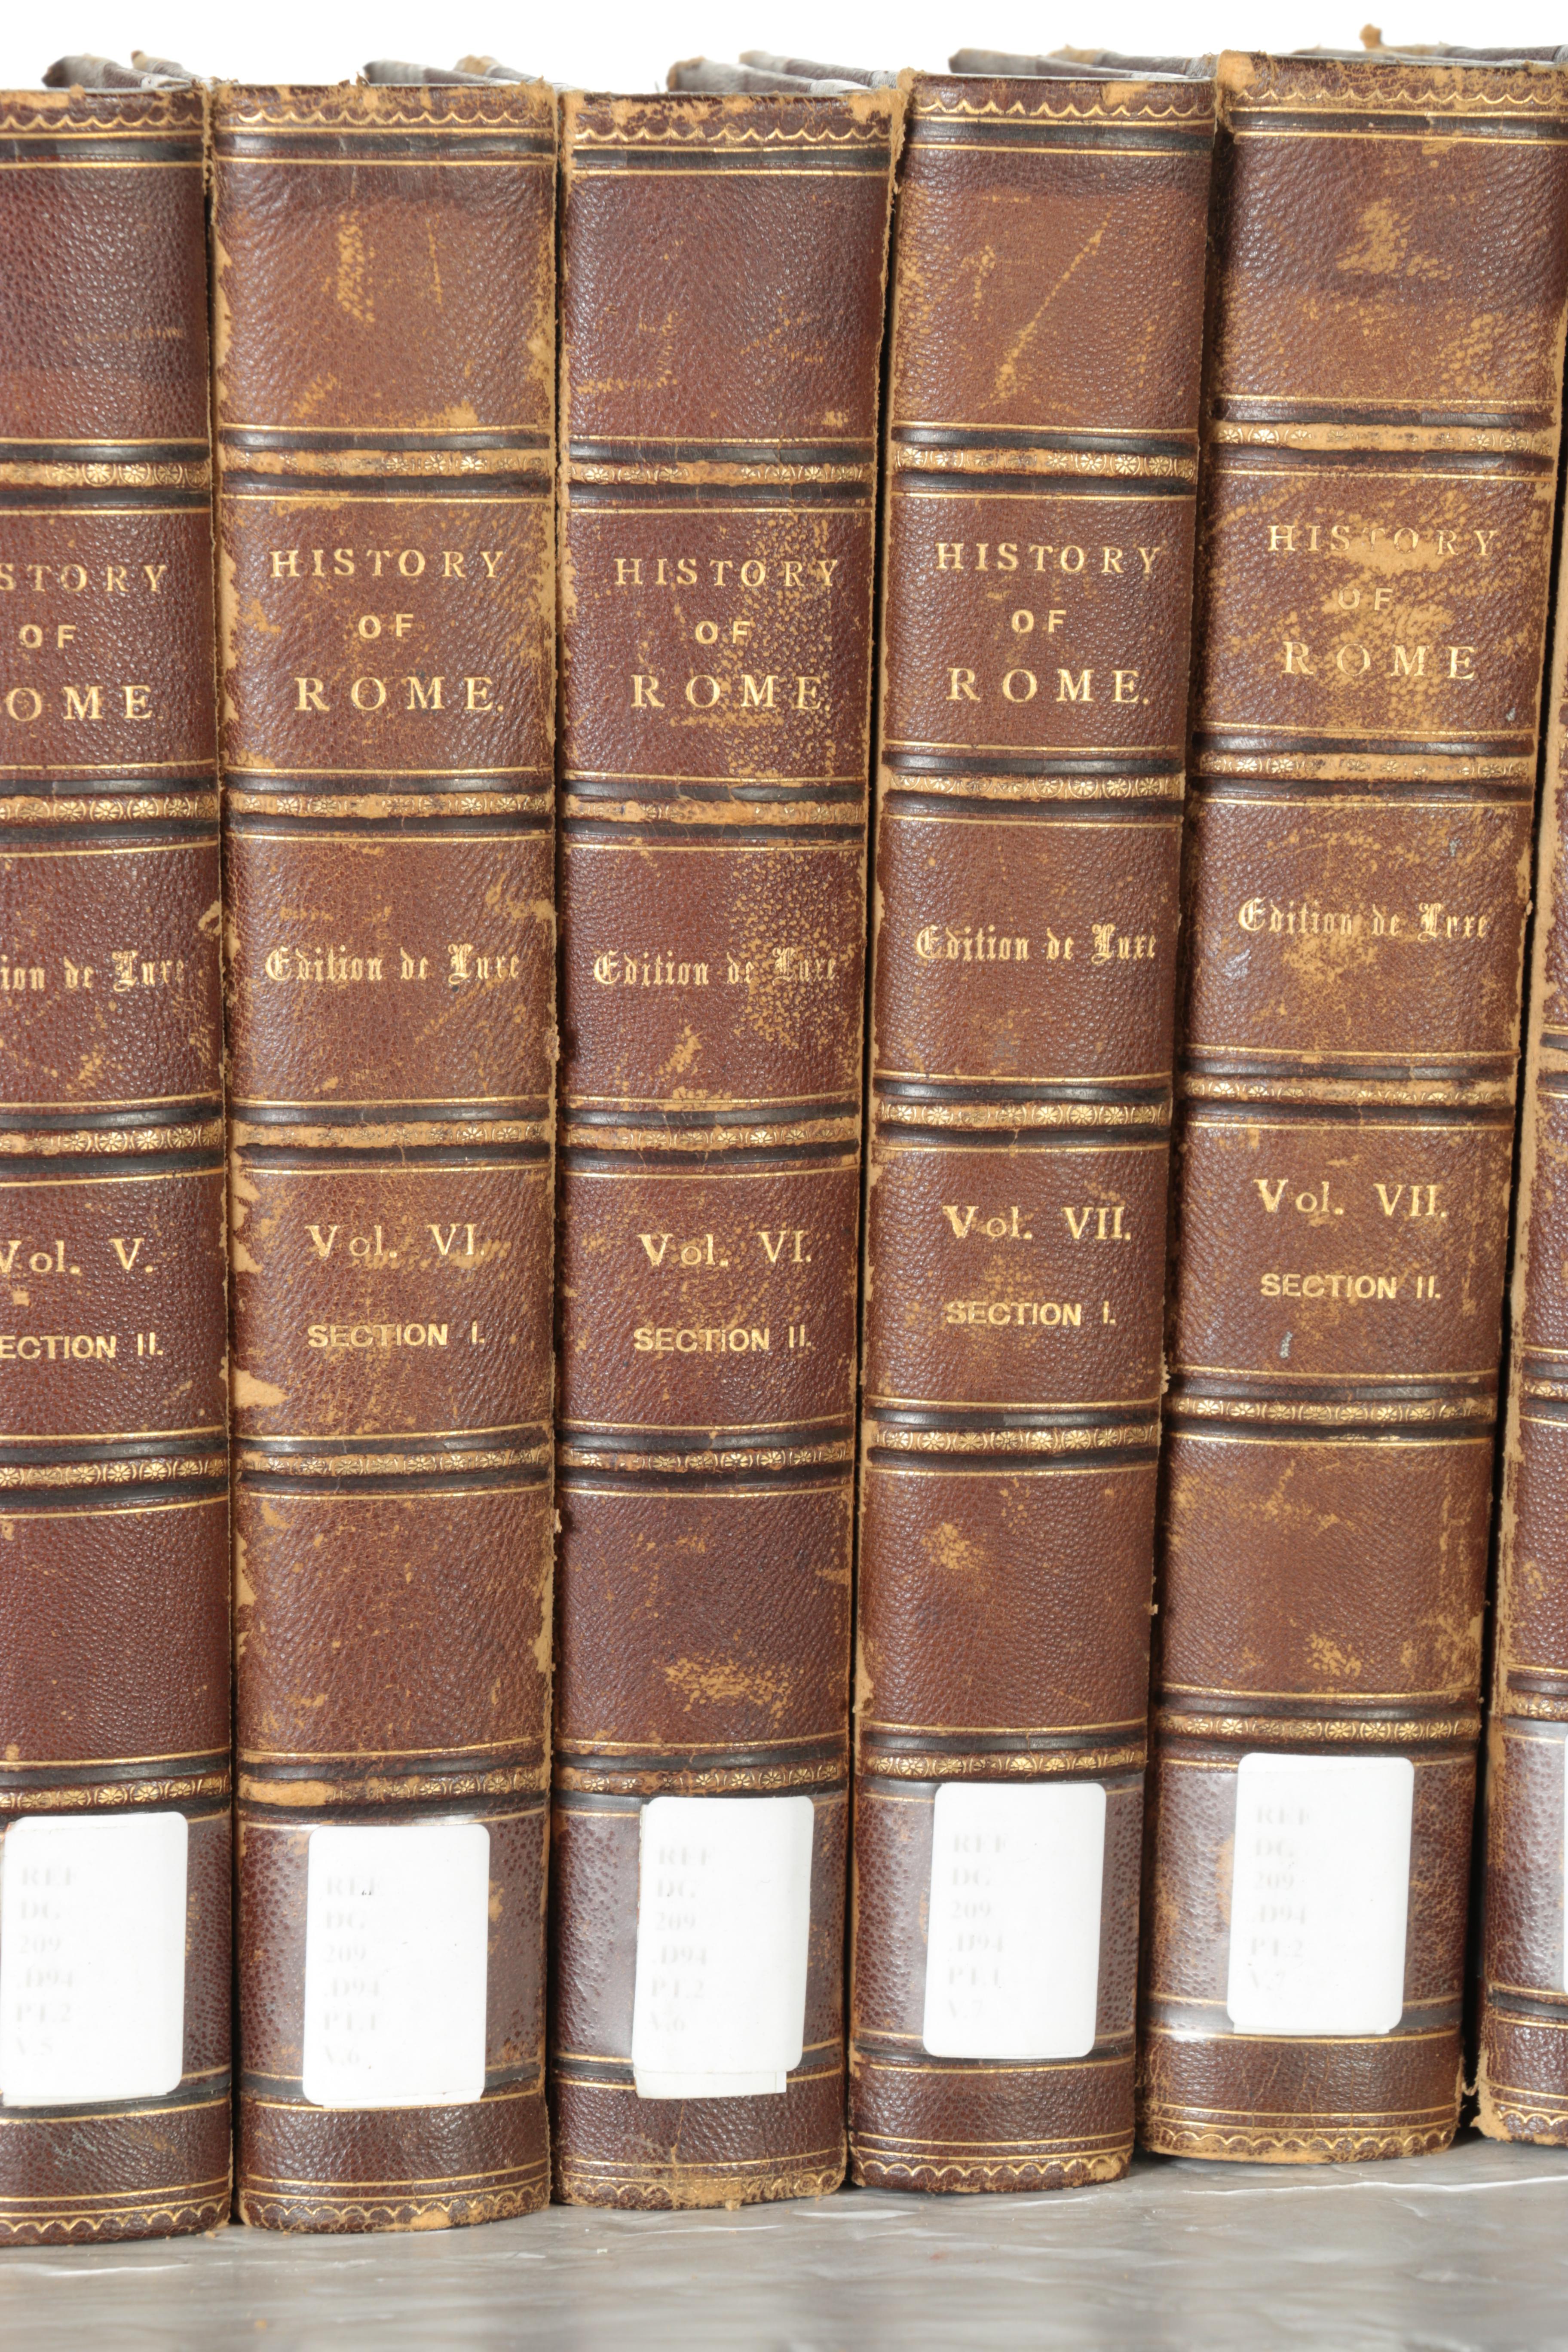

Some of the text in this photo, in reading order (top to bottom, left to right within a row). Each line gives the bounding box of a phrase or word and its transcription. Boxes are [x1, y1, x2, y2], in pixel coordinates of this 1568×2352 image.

[1267, 525, 1497, 556] HISTORY
[270, 548, 504, 578] HISTORY
[615, 558, 837, 587] HISTORY
[935, 543, 1160, 573] HISTORY
[1338, 587, 1393, 611] OF
[358, 613, 414, 639] OF
[695, 621, 751, 644] OF
[1011, 609, 1066, 633] OF
[19, 625, 76, 649] OF
[1281, 641, 1475, 680] ROME
[294, 677, 505, 712] ROME.
[946, 668, 1149, 705] ROME.
[1237, 896, 1352, 935] Edition
[1371, 903, 1400, 936] de
[916, 924, 1029, 962] Edition
[1046, 927, 1074, 960] de
[64, 956, 94, 989] de
[264, 945, 383, 982] Edition
[400, 947, 429, 981] de
[593, 950, 709, 986] Edition
[726, 951, 755, 985] de
[1253, 1179, 1448, 1218] Vol. VII.
[942, 1205, 1131, 1241] Vol. VII.
[108, 1237, 154, 1274] V.
[305, 1223, 484, 1259] Vol. VI.
[637, 1230, 812, 1267] Vol. VI.
[1261, 1273, 1441, 1299] SECTION II.
[946, 1300, 1116, 1326] SECTION I.
[0, 1332, 163, 1360] ECTION II.
[308, 1320, 485, 1348] SECTION I.
[634, 1324, 812, 1352] SECTION II.
